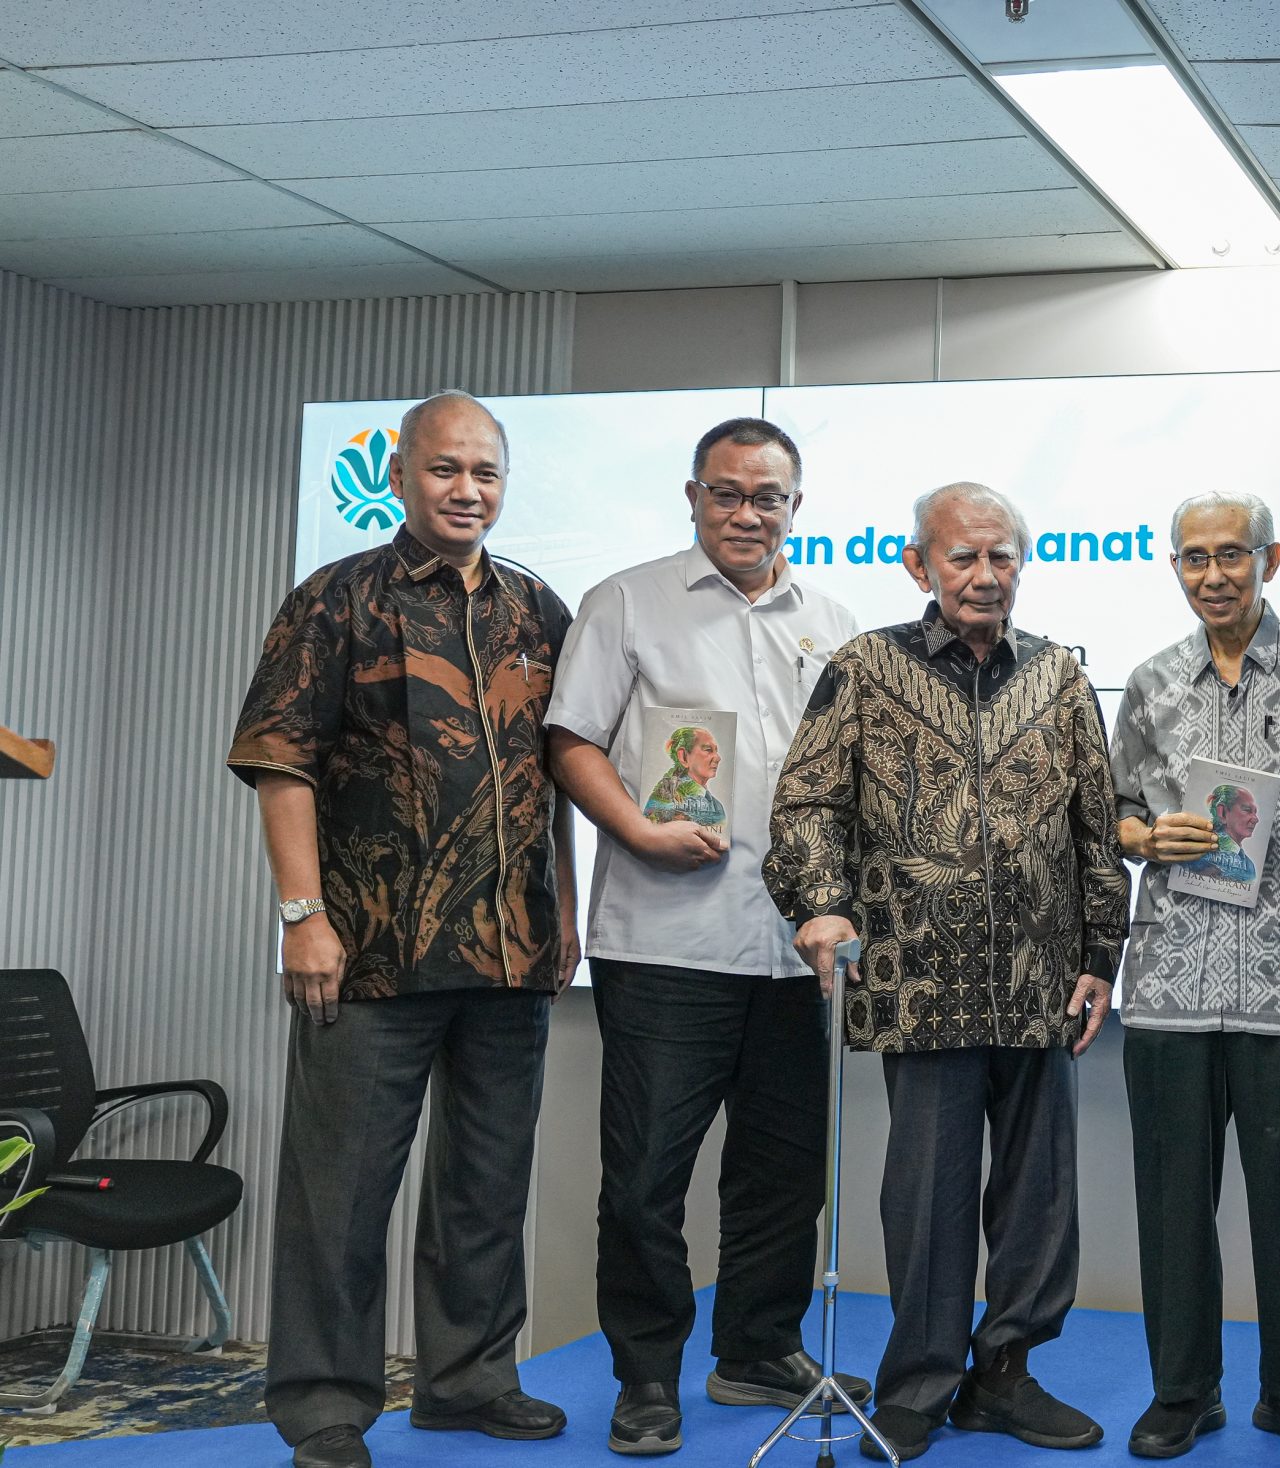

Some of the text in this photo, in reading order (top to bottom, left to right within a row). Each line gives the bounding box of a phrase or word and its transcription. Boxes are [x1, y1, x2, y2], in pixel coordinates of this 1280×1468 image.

[846, 526, 911, 565] da
[1025, 525, 1154, 562] anat
[1178, 866, 1205, 882] JEJAK
[1208, 873, 1252, 892] NURANI
